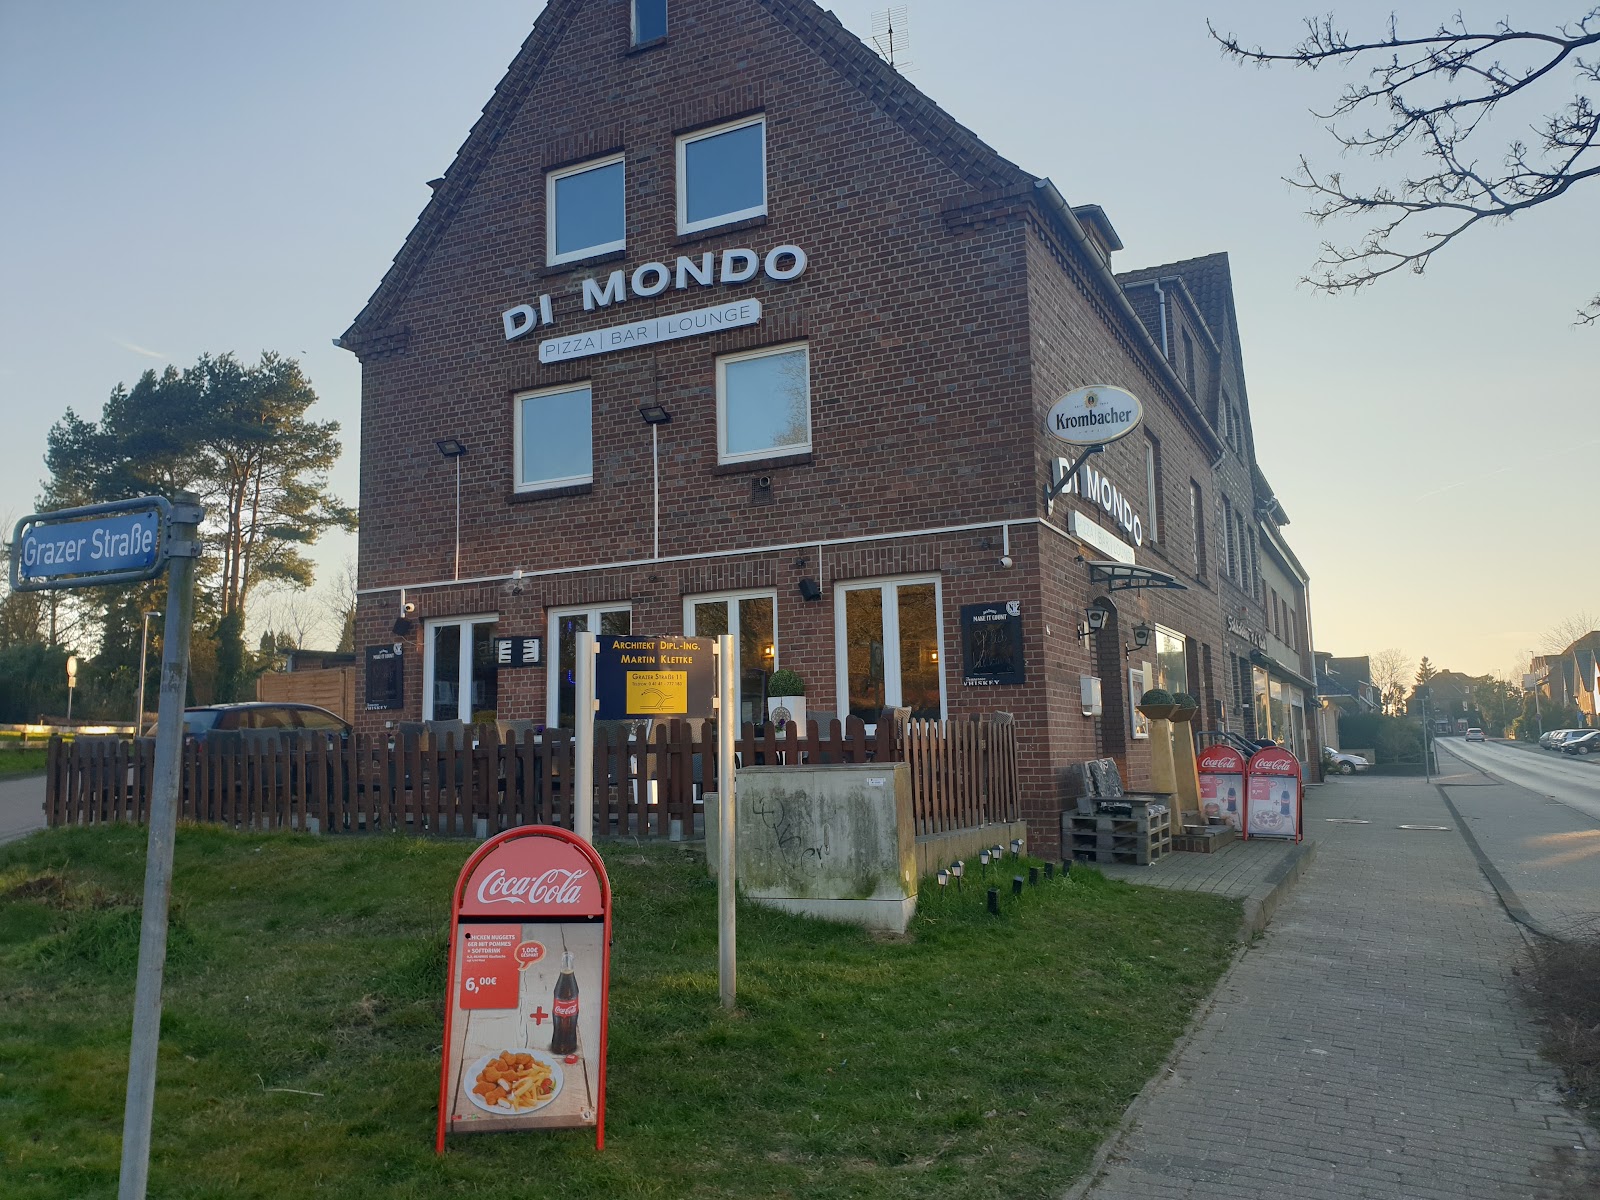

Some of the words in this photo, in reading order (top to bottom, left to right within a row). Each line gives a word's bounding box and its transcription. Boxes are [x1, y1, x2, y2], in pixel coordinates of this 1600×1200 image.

[502, 293, 554, 341] DI
[581, 244, 808, 312] MONDO
[544, 337, 595, 357] PIZZA
[610, 326, 648, 345] BAR
[668, 305, 751, 334] LOUNGE
[1056, 407, 1132, 430] Krombacher
[1085, 465, 1142, 546] MONDO
[24, 536, 87, 567] Grazer
[90, 522, 153, 560] Straße
[612, 640, 655, 650] ARCHITEKT
[620, 655, 655, 664] MARTIN
[660, 655, 693, 664] KLETTKE
[1201, 757, 1237, 768] Coca-Cola
[1255, 758, 1292, 771] Coca-Cola
[477, 868, 590, 904] Coca-Cola
[465, 977, 497, 994] 6,00€
